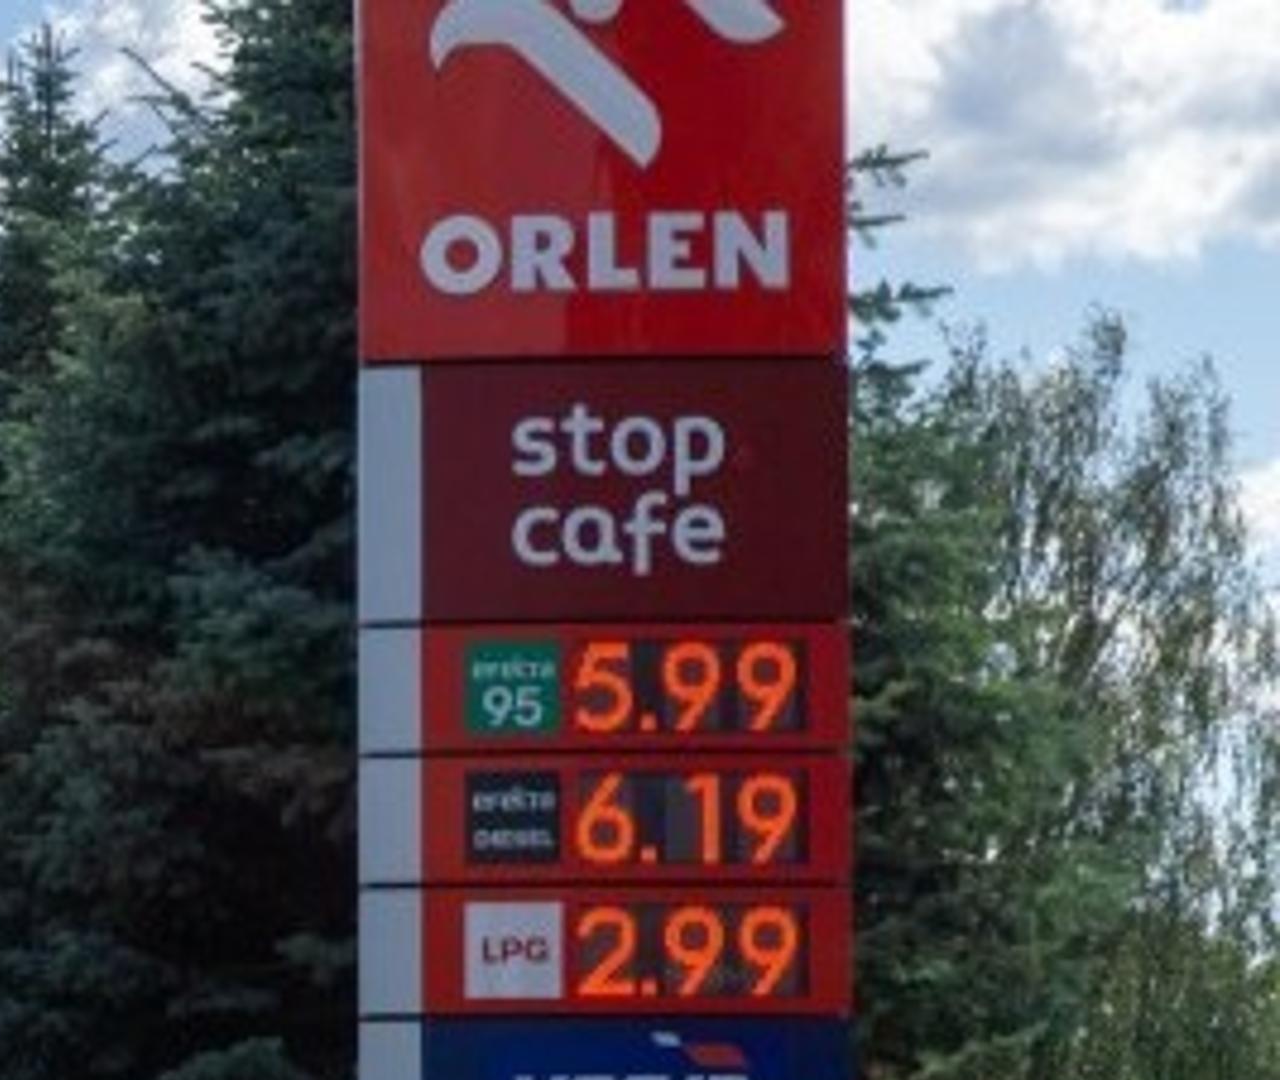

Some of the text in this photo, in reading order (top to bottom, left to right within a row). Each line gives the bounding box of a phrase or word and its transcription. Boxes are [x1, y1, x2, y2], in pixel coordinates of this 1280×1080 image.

[420, 210, 790, 295] ORLEN
[511, 402, 725, 496] stop
[511, 491, 725, 576] cafe
[481, 684, 544, 727] 95
[574, 640, 798, 732] 5.99
[576, 772, 798, 863] 6.19
[481, 934, 550, 964] LPG
[577, 905, 799, 997] 2.99
